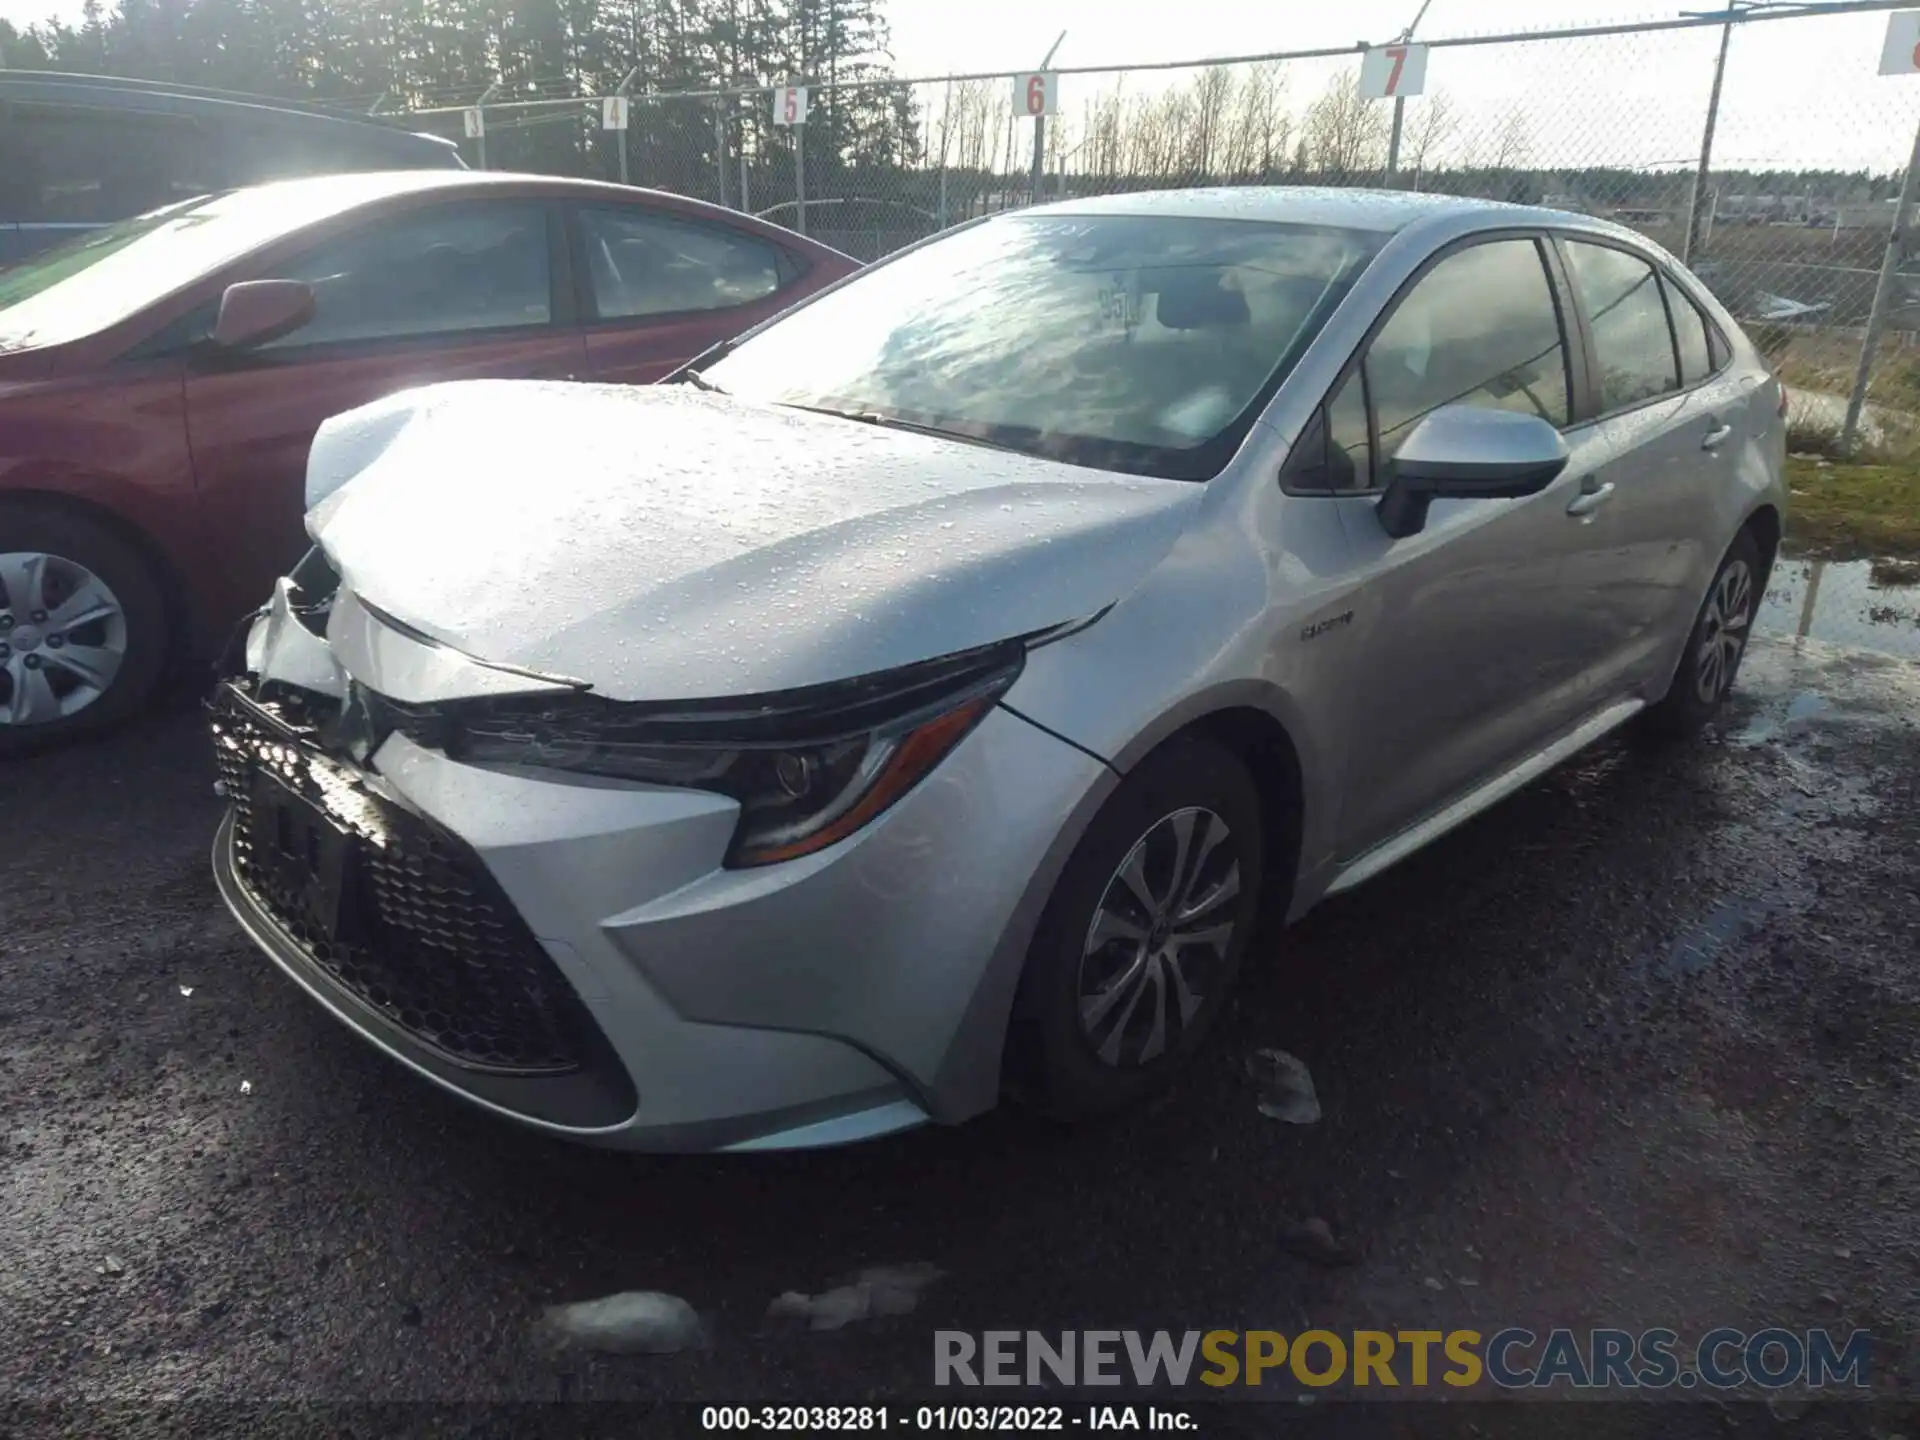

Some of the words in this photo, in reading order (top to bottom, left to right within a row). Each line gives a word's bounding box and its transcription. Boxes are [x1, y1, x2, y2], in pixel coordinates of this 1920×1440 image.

[1384, 48, 1407, 95] 7
[785, 89, 797, 122] 5
[1026, 75, 1045, 115] 6
[470, 111, 479, 136] 3
[609, 99, 620, 128] 4
